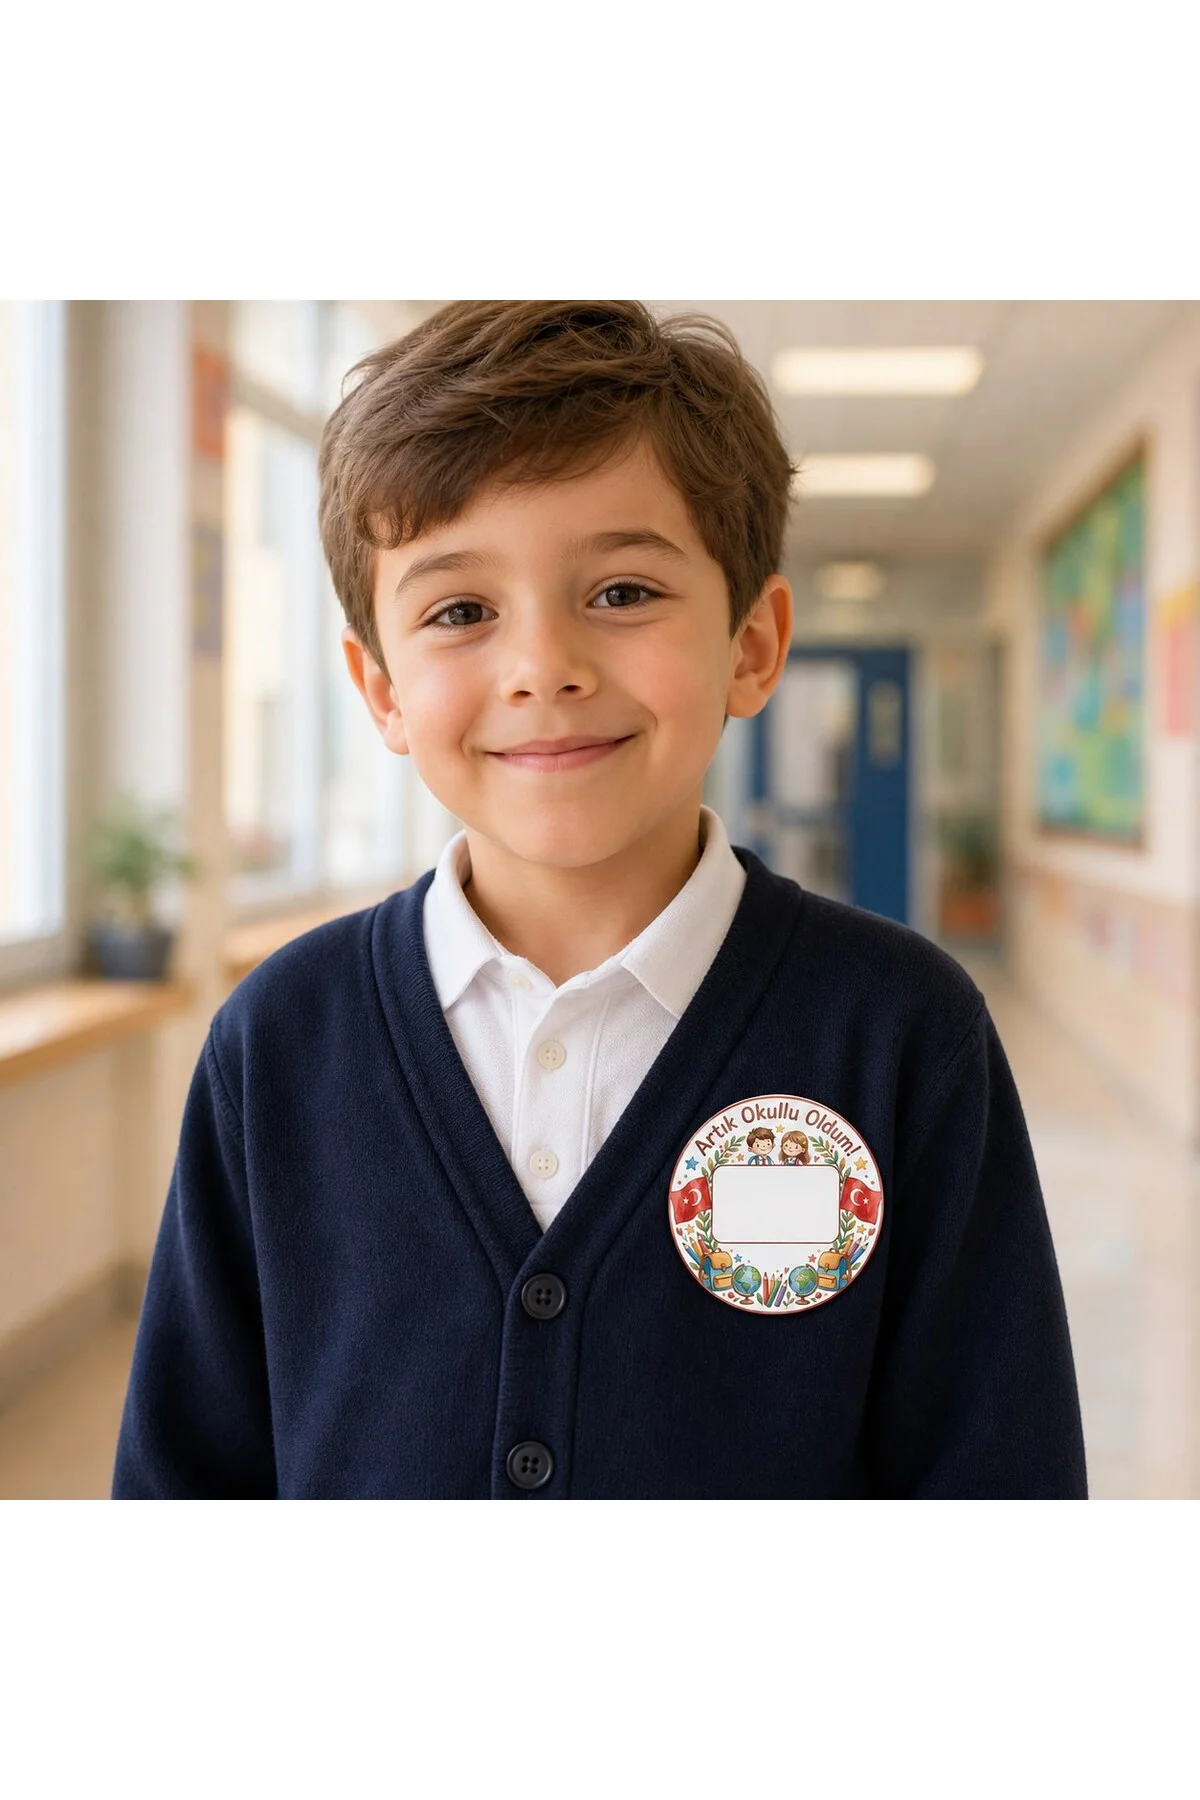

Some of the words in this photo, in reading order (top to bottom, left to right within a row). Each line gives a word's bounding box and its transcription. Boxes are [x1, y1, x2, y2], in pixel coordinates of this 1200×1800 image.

[695, 1115, 738, 1156] Artık
[741, 1102, 799, 1123] Okullu
[805, 1109, 862, 1157] Oldum!
